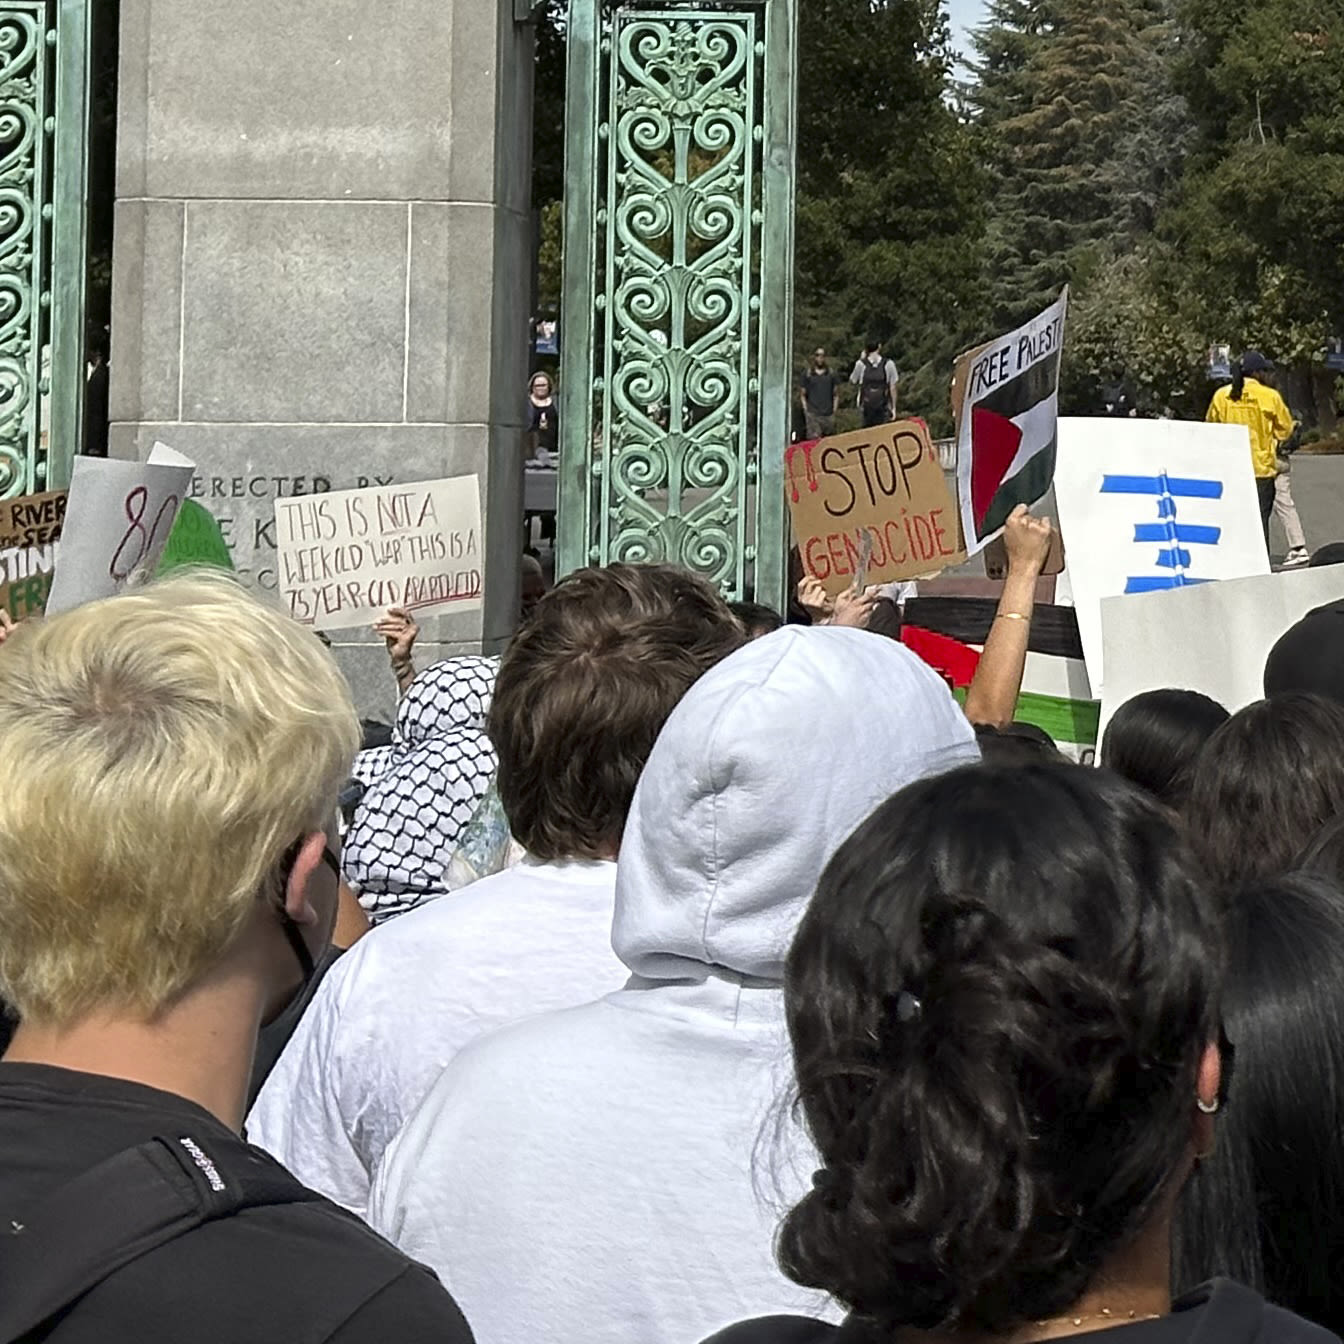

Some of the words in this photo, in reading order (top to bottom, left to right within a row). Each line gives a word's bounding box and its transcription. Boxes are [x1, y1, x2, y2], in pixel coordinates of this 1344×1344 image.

[968, 345, 1011, 399] FREE
[189, 475, 331, 498] ERECTED
[820, 430, 923, 517] STOP
[11, 495, 67, 529] RIVER
[280, 498, 337, 542] THIS
[346, 496, 369, 538] IS
[376, 492, 417, 533] NOT
[416, 492, 439, 528] A
[408, 532, 446, 564] THIS
[450, 531, 464, 560] IS
[467, 528, 478, 556] A
[285, 588, 310, 621] 75
